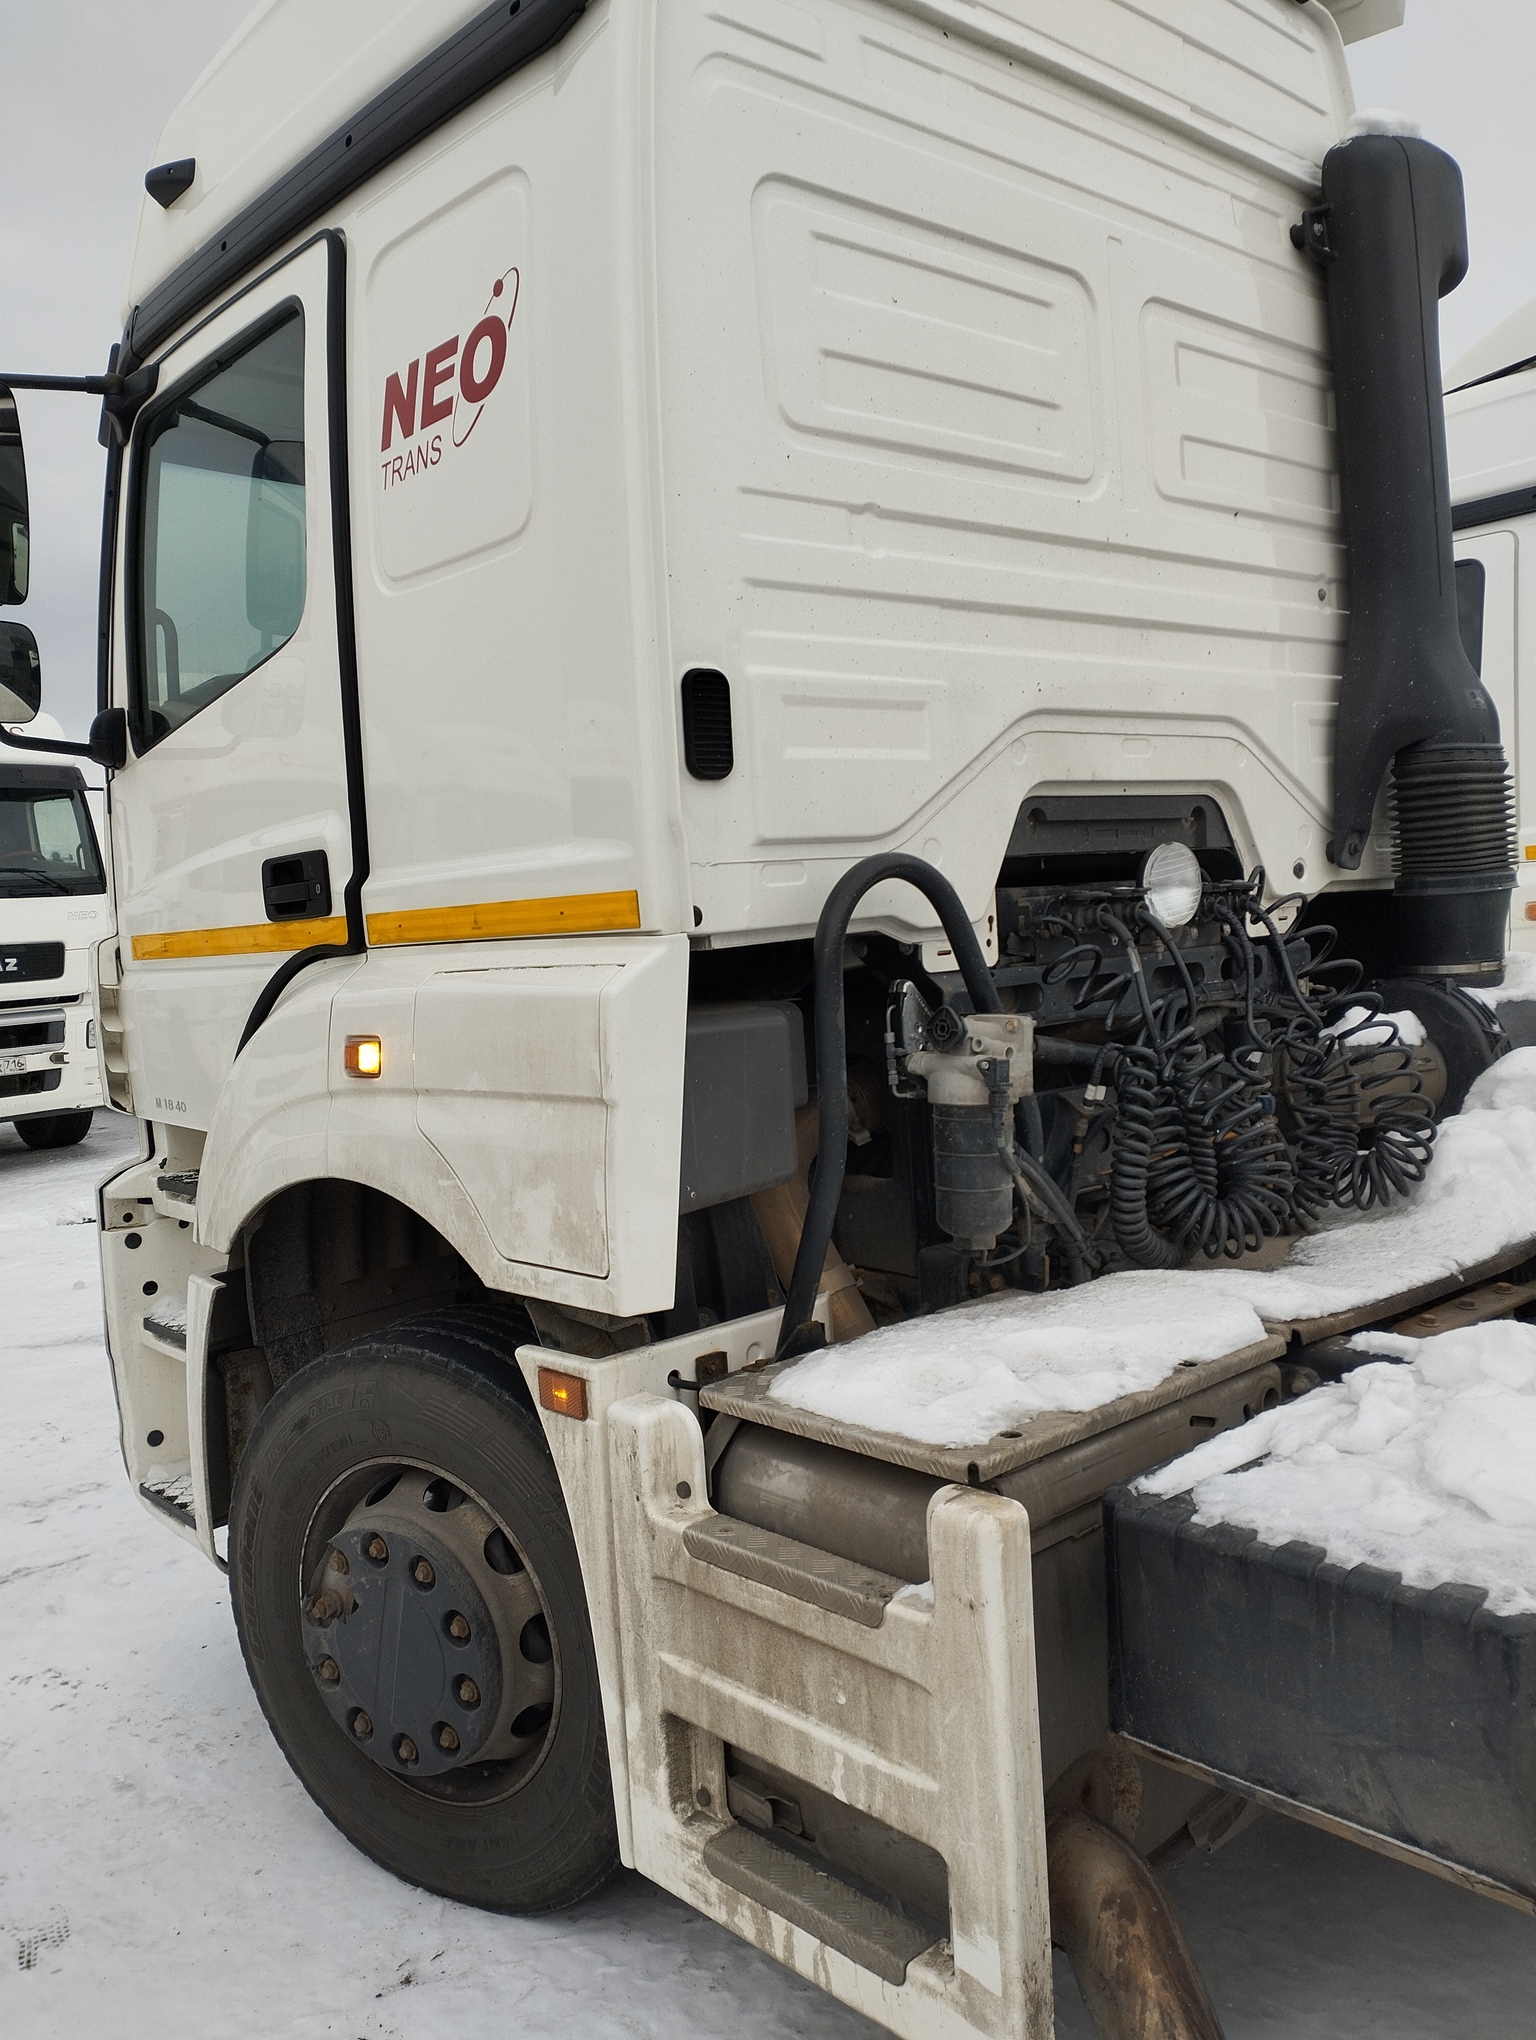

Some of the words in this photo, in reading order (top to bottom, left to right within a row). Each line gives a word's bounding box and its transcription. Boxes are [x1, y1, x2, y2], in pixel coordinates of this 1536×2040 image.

[381, 314, 508, 453] NEO
[381, 434, 443, 491] TRANS
[67, 910, 99, 920] NEO
